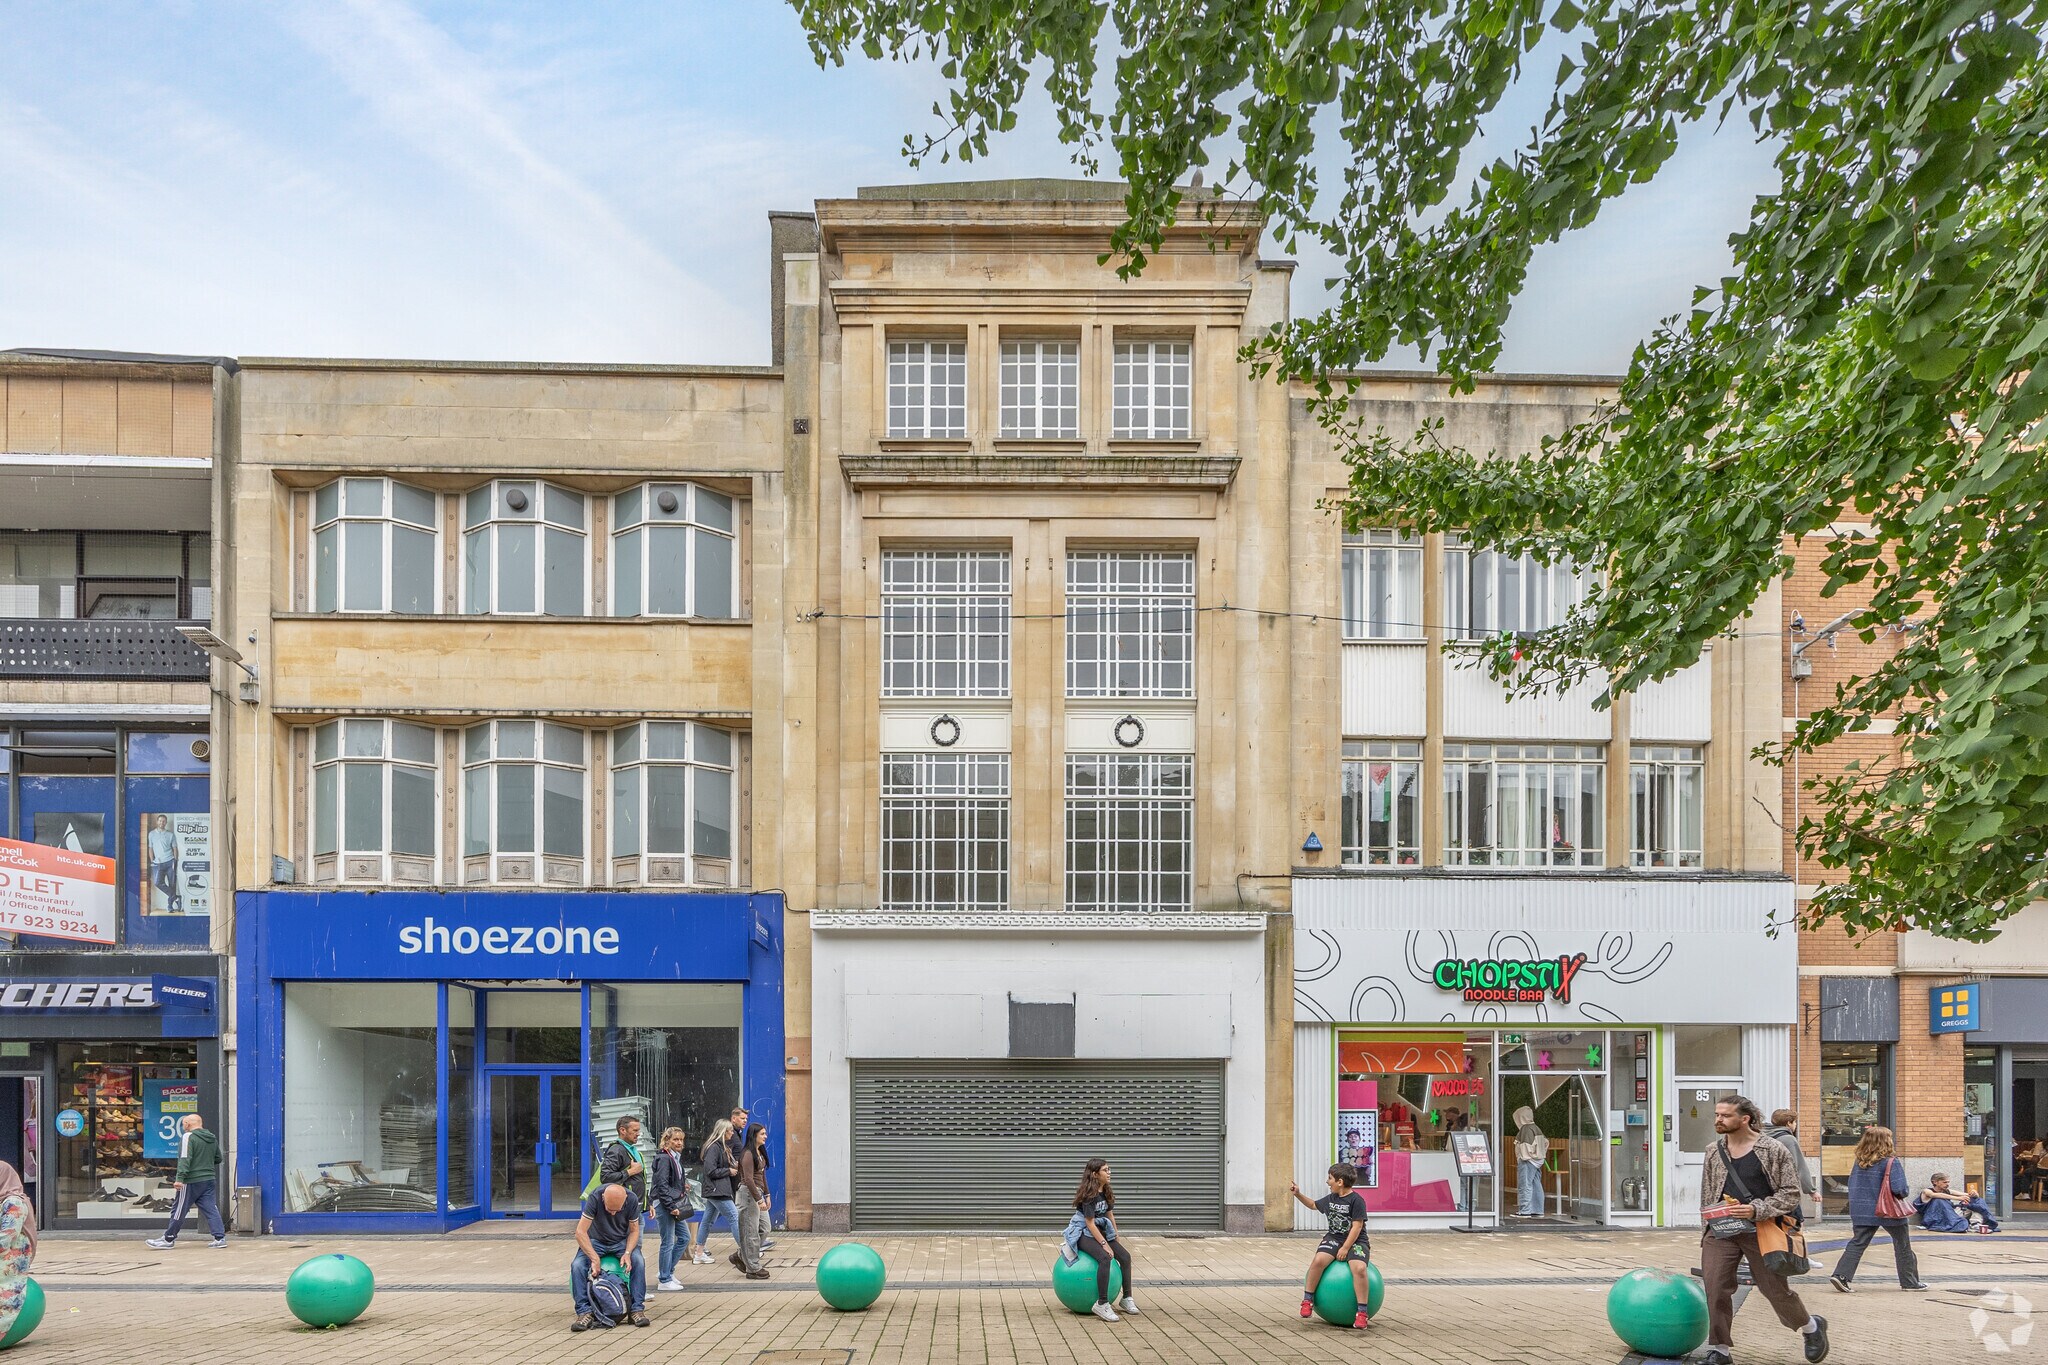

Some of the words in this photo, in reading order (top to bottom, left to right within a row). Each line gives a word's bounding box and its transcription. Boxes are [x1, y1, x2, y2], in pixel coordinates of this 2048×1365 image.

[57, 855, 106, 870] htc.uk.com
[20, 876, 64, 895] LET
[15, 892, 68, 906] Restaurant
[9, 900, 39, 911] Office
[47, 906, 84, 917] Medical
[23, 915, 54, 929] 923
[60, 920, 98, 935] 9234
[398, 917, 620, 955] shoezone
[0, 983, 156, 1008] CHERS
[161, 985, 207, 998] SKECHERS
[1465, 989, 1516, 1001] NOODLE
[1519, 989, 1544, 1001] BAR
[1941, 1019, 1969, 1028] GREGGS
[162, 1087, 188, 1096] BACK
[1696, 1090, 1710, 1102] 85
